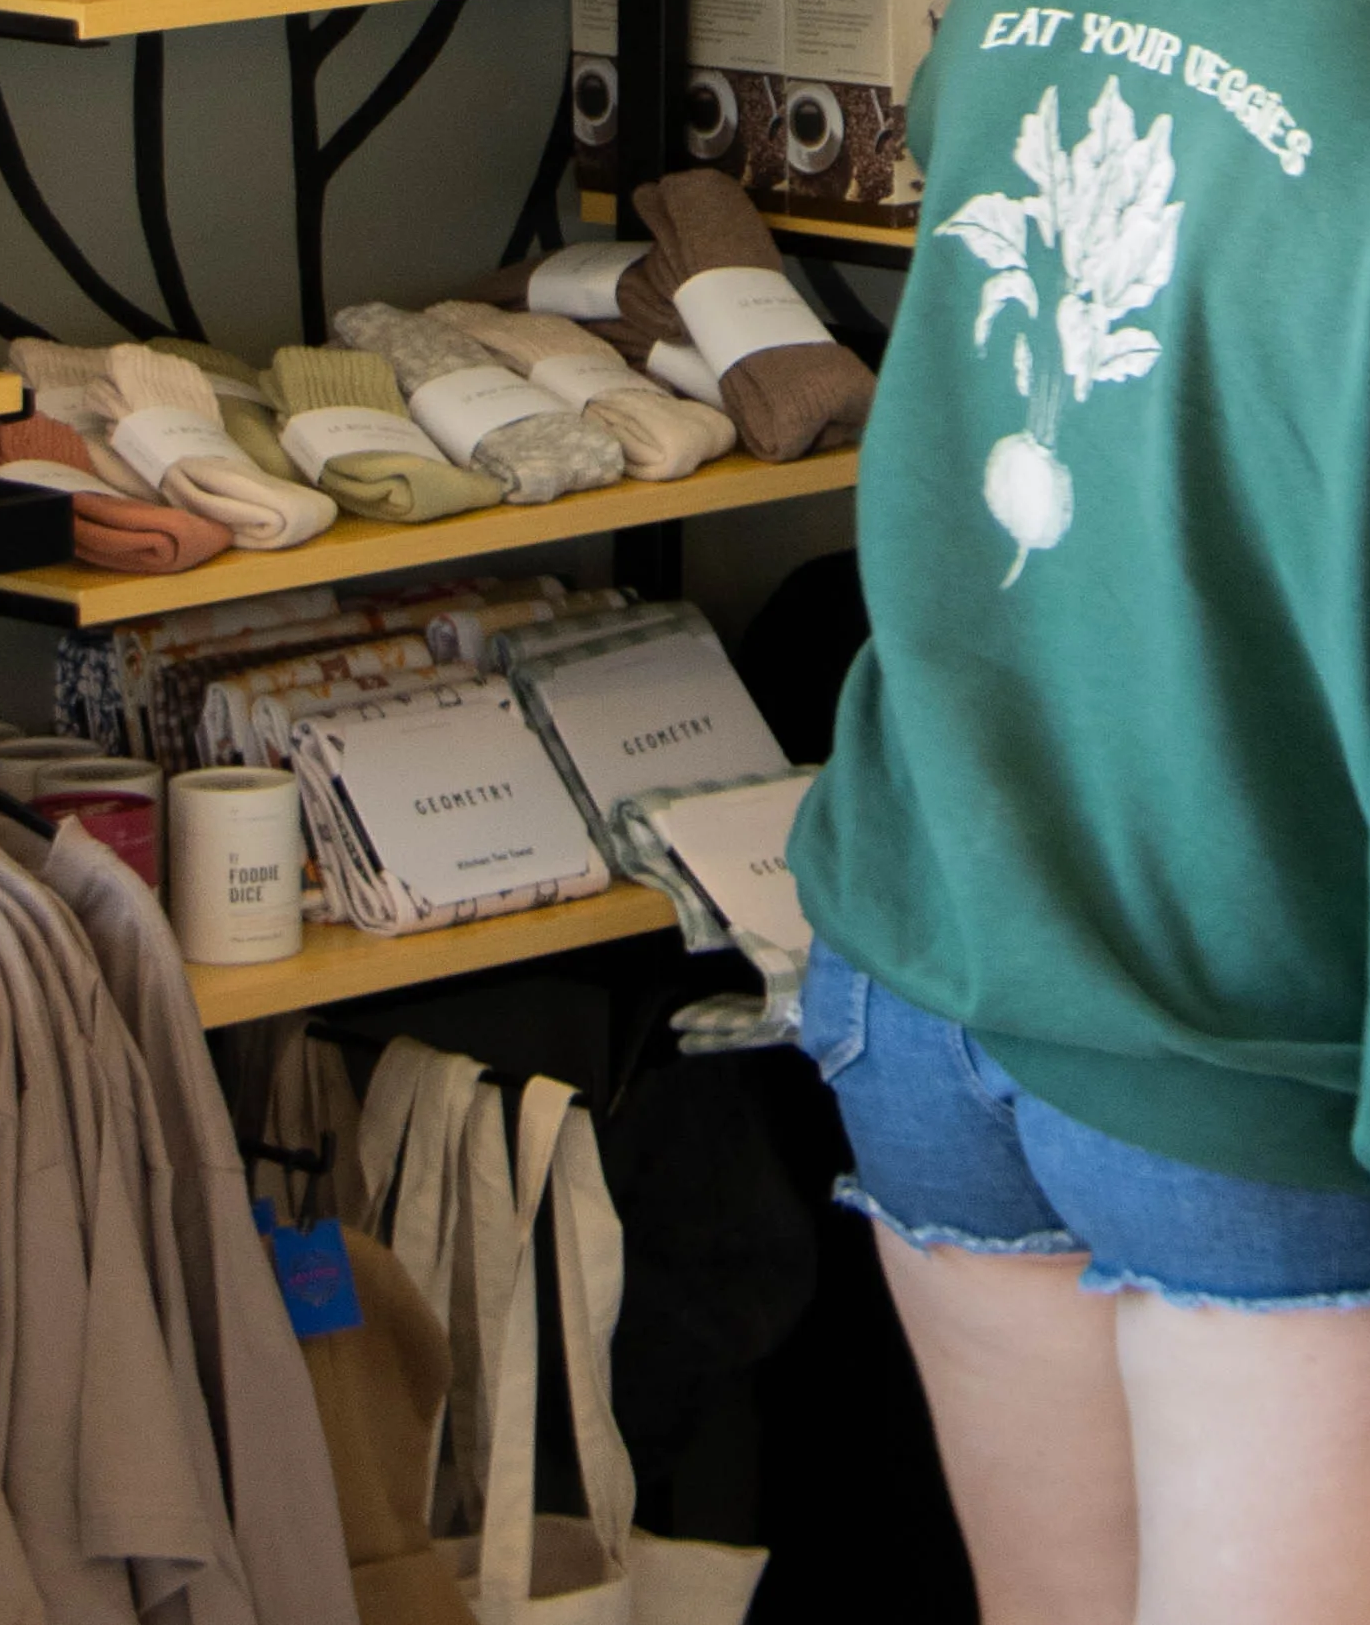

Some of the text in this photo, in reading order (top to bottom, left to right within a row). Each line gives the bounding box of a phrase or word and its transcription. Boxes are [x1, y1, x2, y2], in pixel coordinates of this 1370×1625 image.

[981, 7, 1313, 177] EAT YOUR VEGGIES
[623, 715, 713, 756] GEOMETRY
[414, 782, 513, 816] GEOMETRY
[229, 864, 280, 884] FOODIE
[229, 886, 263, 904] DICE
